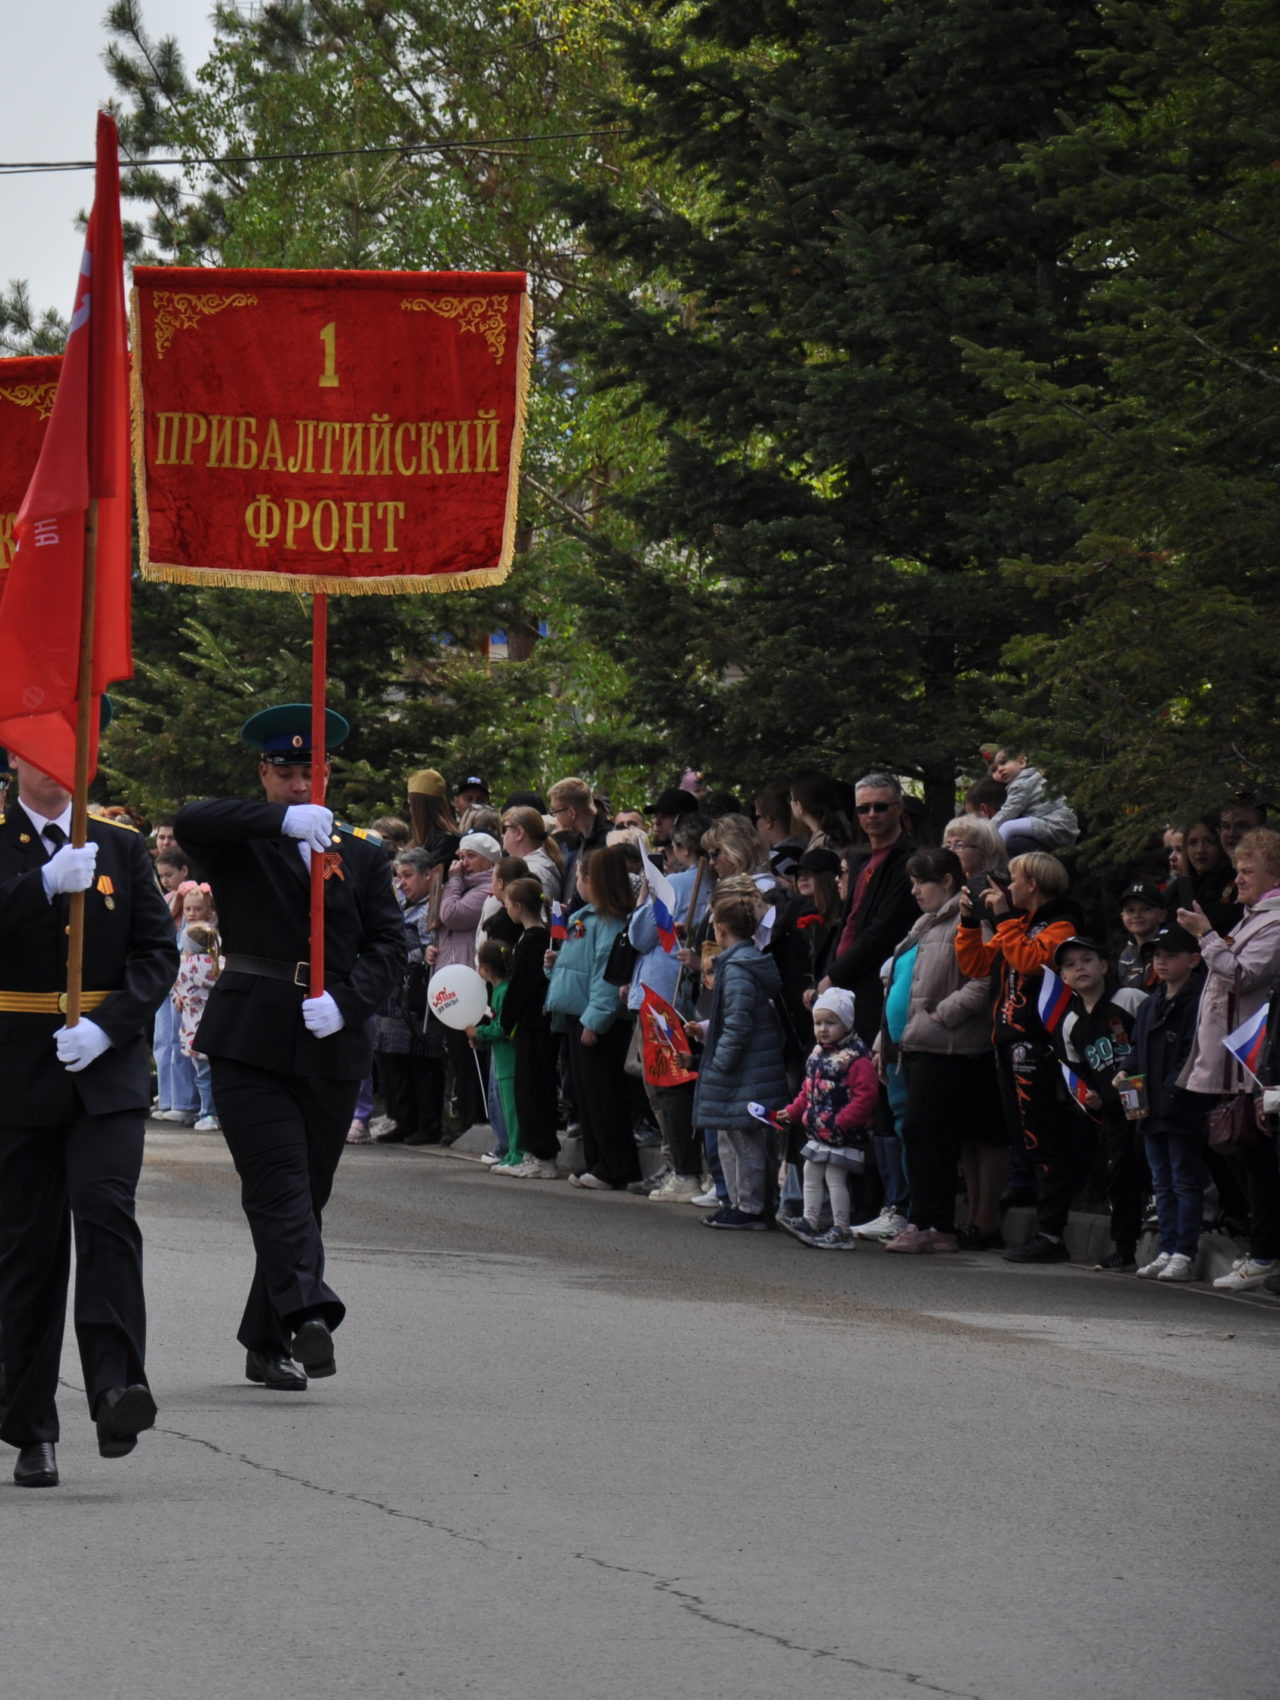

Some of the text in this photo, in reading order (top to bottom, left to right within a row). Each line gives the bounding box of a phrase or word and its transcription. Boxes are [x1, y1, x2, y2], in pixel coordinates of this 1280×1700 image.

[318, 321, 340, 387] 1
[154, 408, 501, 476] ПРИБАЛТИЙСКИЙ
[245, 493, 405, 553] ФРОНТ
